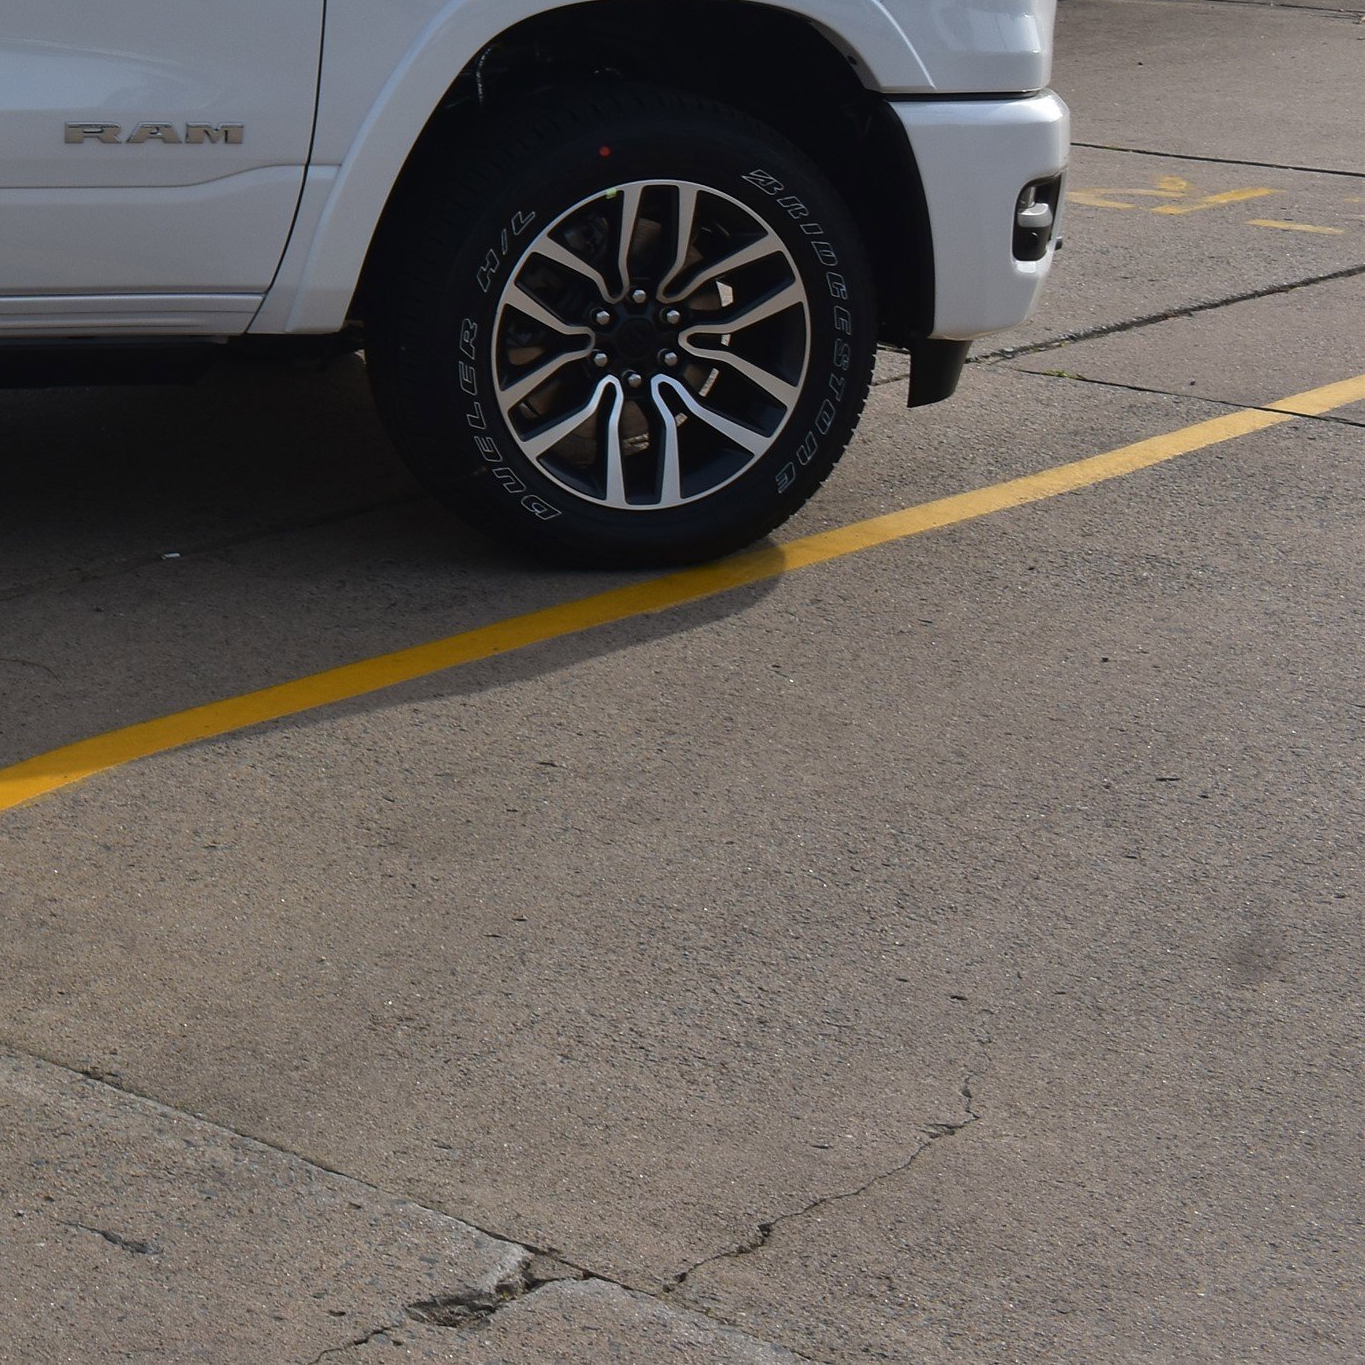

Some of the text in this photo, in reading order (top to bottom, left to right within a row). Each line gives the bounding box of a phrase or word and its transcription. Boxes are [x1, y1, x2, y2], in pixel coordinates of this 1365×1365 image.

[64, 121, 245, 144] RAM
[459, 318, 562, 522] DUELER
[742, 168, 852, 495] BRIDGESTONE
